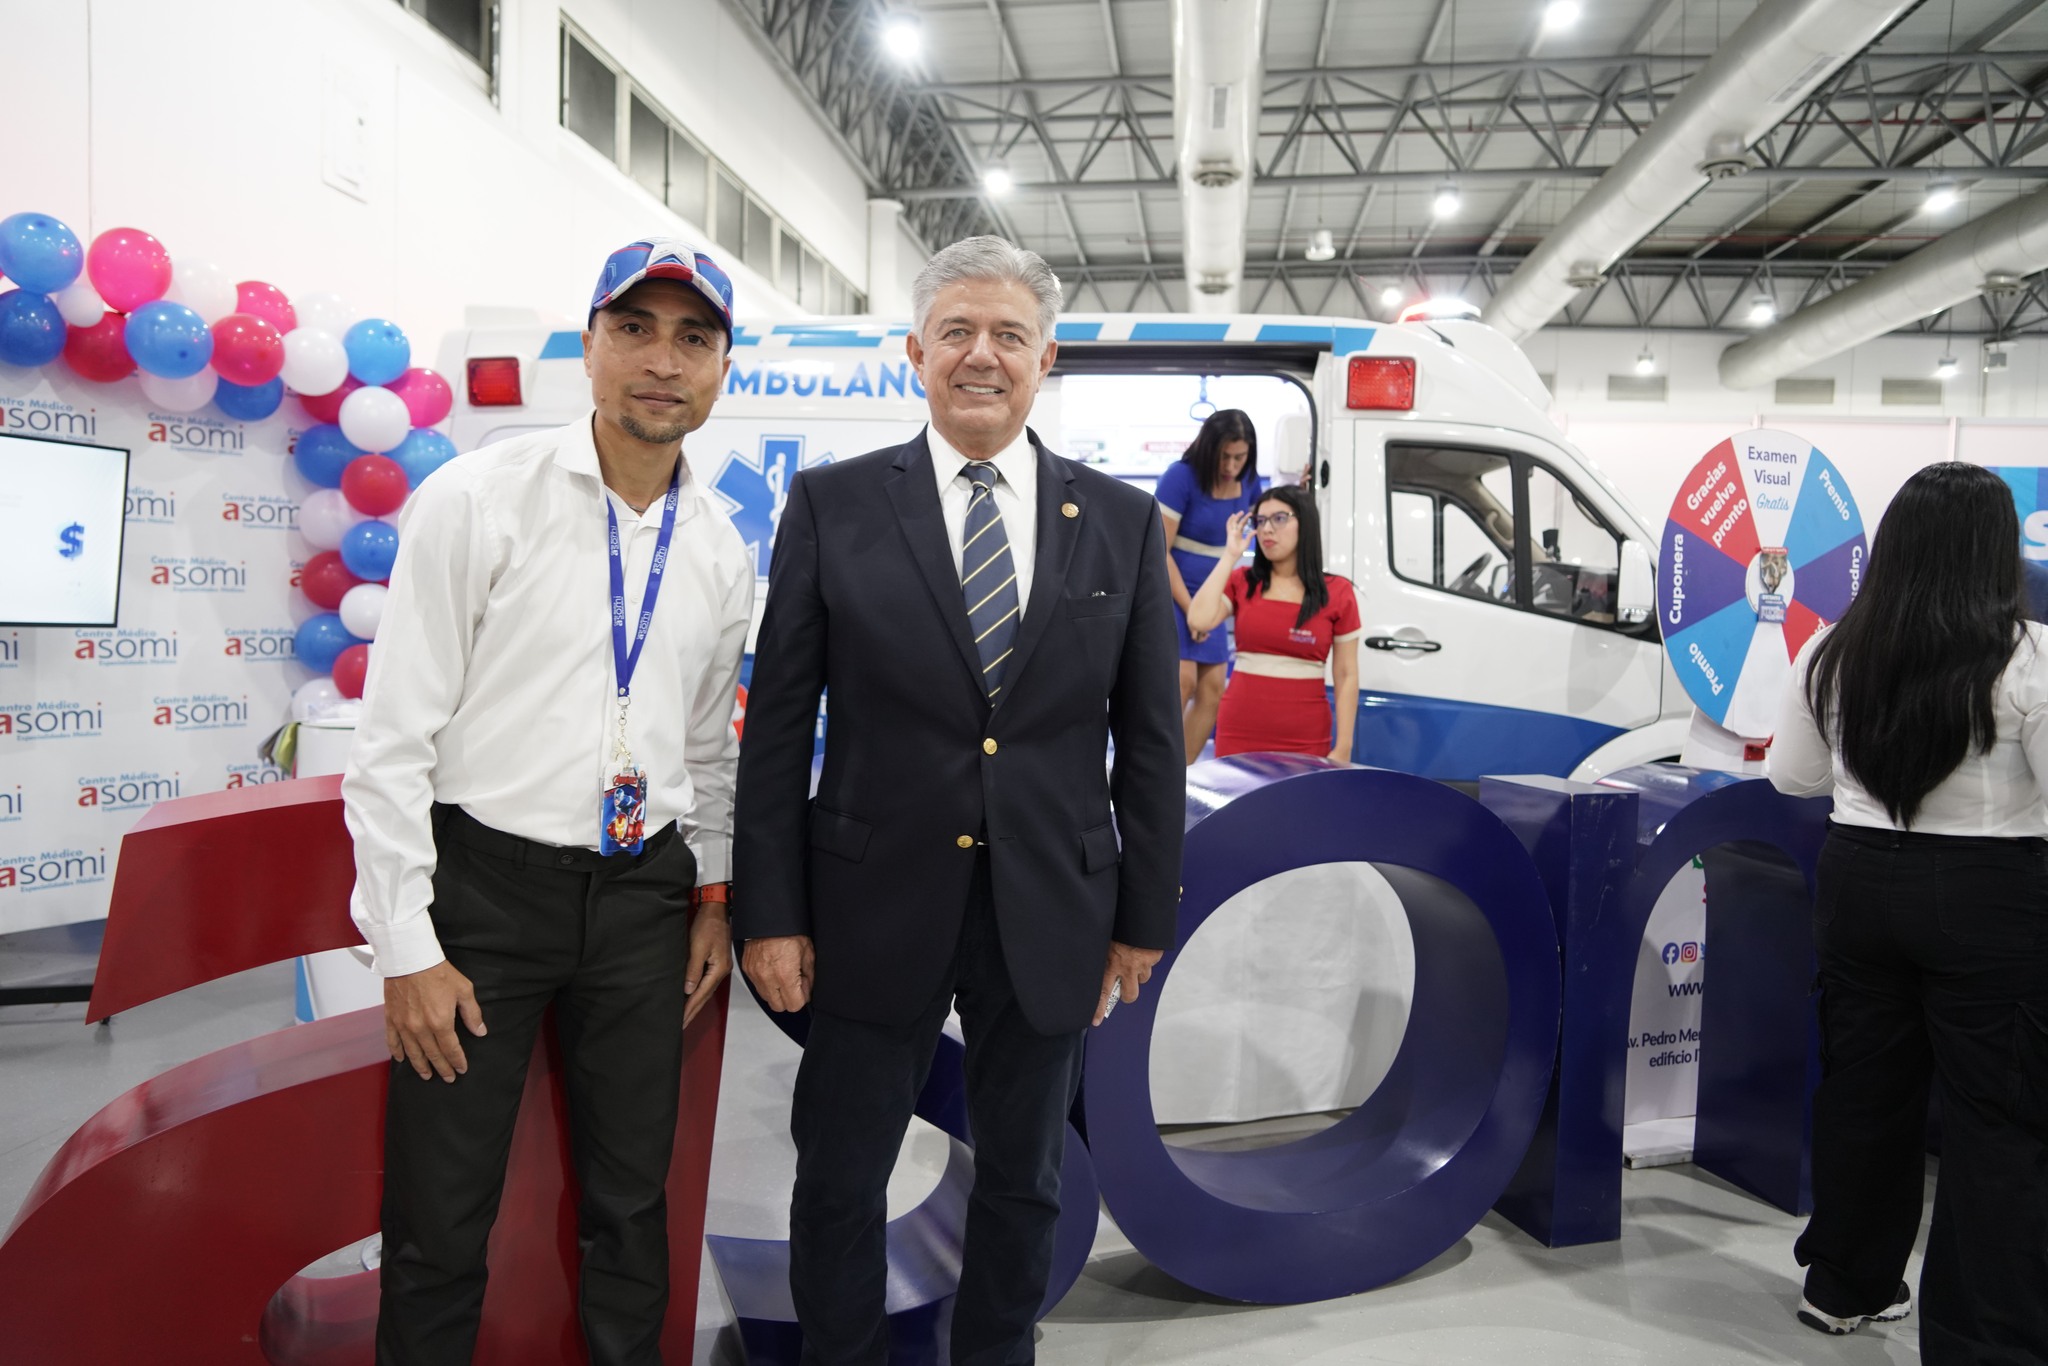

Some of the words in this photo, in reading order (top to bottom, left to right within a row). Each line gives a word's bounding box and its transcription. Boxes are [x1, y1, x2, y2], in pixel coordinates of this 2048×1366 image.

[720, 360, 927, 399] MBULANC
[0, 407, 96, 435] somi
[148, 422, 243, 449] asomi
[1748, 446, 1797, 464] Examen
[1686, 461, 1727, 511] Gracias
[1754, 469, 1791, 486] Visual
[1700, 481, 1737, 527] vuelva
[1756, 493, 1790, 511] Gratis
[1819, 468, 1851, 522] Premio
[1711, 498, 1748, 549] pronto
[59, 521, 85, 560] $
[151, 560, 246, 586] asomi
[654, 545, 668, 575] asomi
[1669, 533, 1686, 624] Cuponera
[613, 595, 624, 627] asomi
[638, 611, 652, 640] asomi
[74, 631, 178, 660] asomi
[1688, 642, 1724, 696] Premio
[0, 702, 102, 735] asomi
[37, 701, 80, 710] Médico
[153, 694, 247, 726] asomi
[78, 771, 180, 807] asomi
[0, 847, 105, 888] asomi
[40, 848, 83, 860] Médico
[1642, 1031, 1677, 1047] Pedro
[1649, 1050, 1692, 1067] edificio
